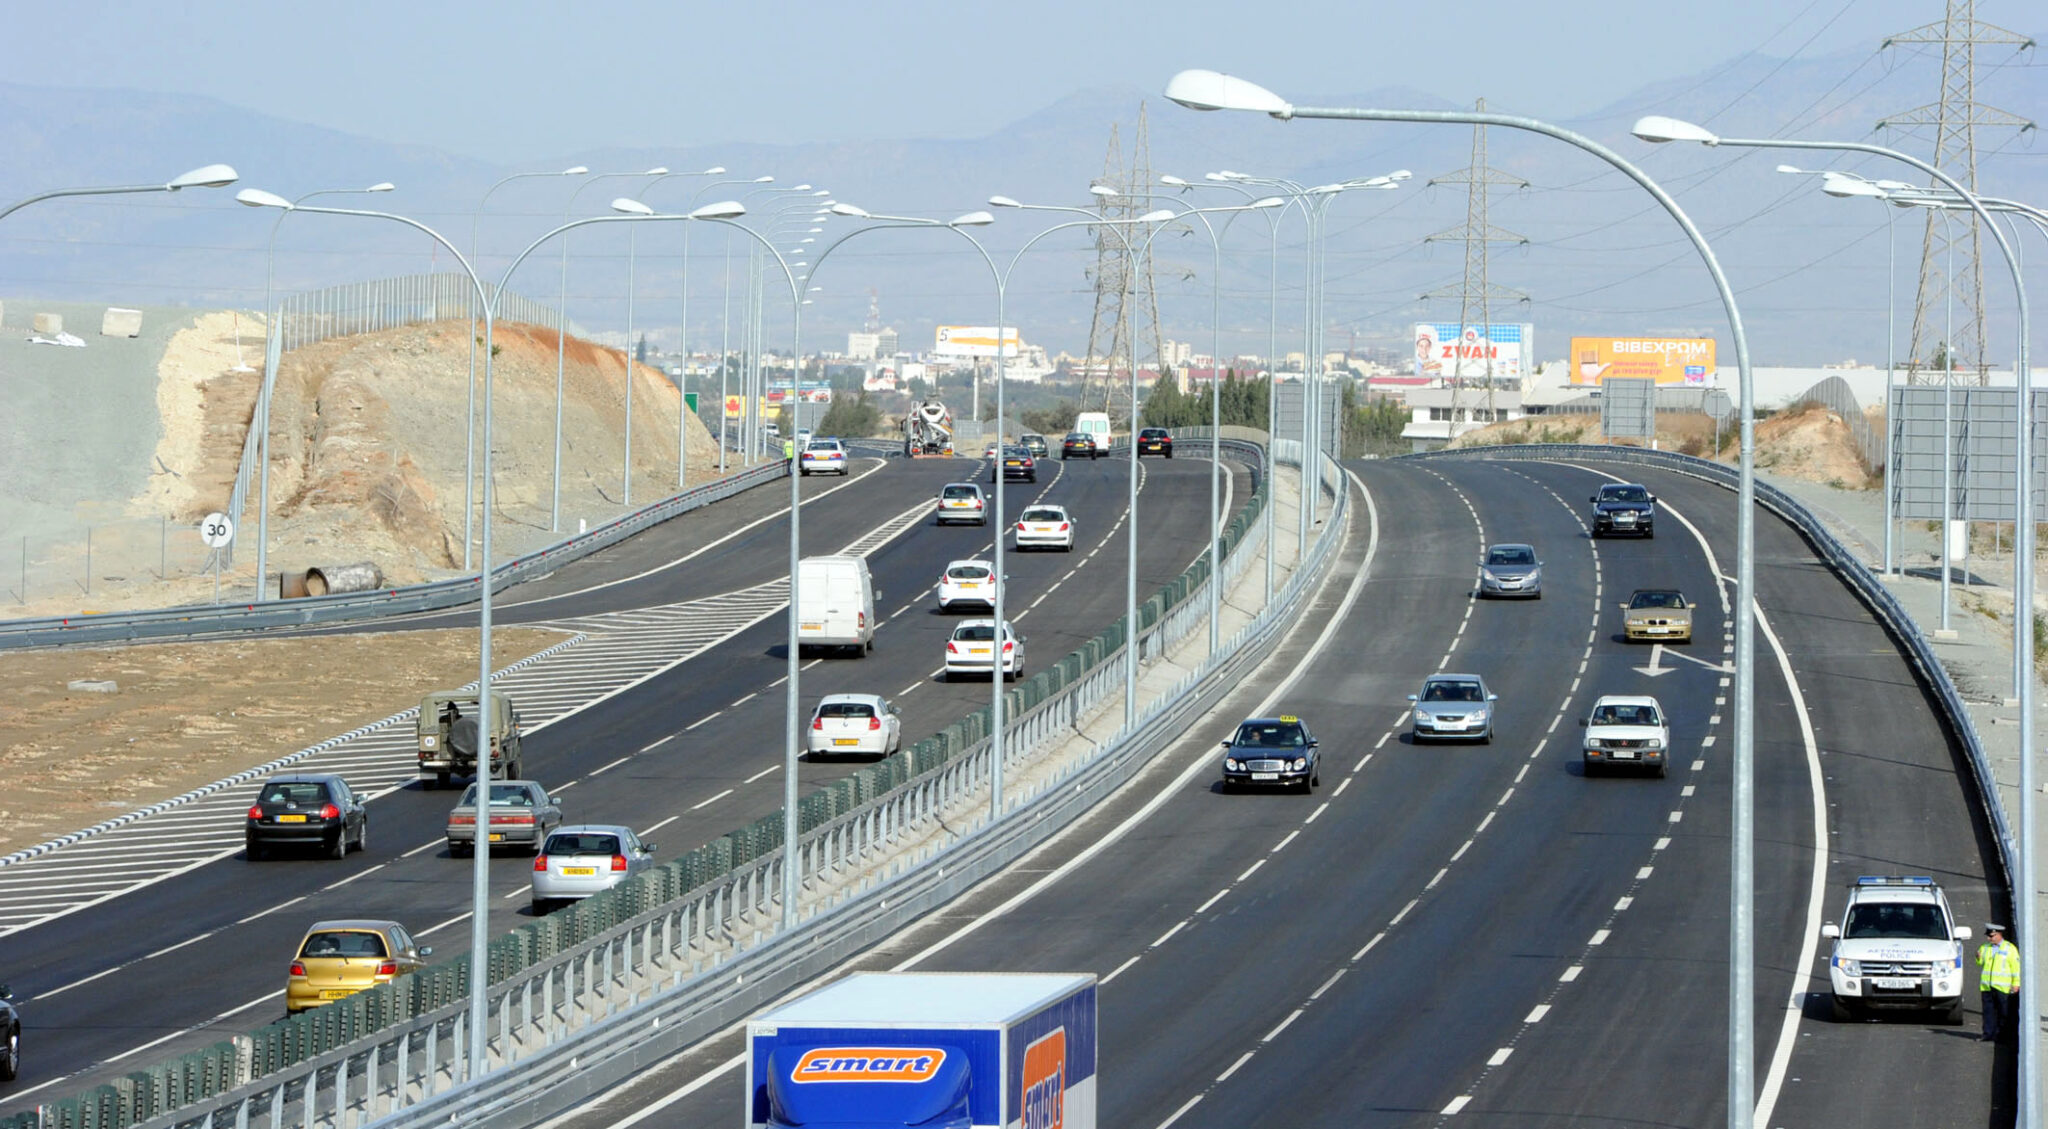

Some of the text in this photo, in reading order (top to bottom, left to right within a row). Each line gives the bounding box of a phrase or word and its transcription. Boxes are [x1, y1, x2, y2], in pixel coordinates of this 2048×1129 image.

[1441, 345, 1497, 359] ZWAN
[207, 524, 227, 537] 30
[802, 1056, 933, 1073] smart
[1024, 1061, 1062, 1129] smart
